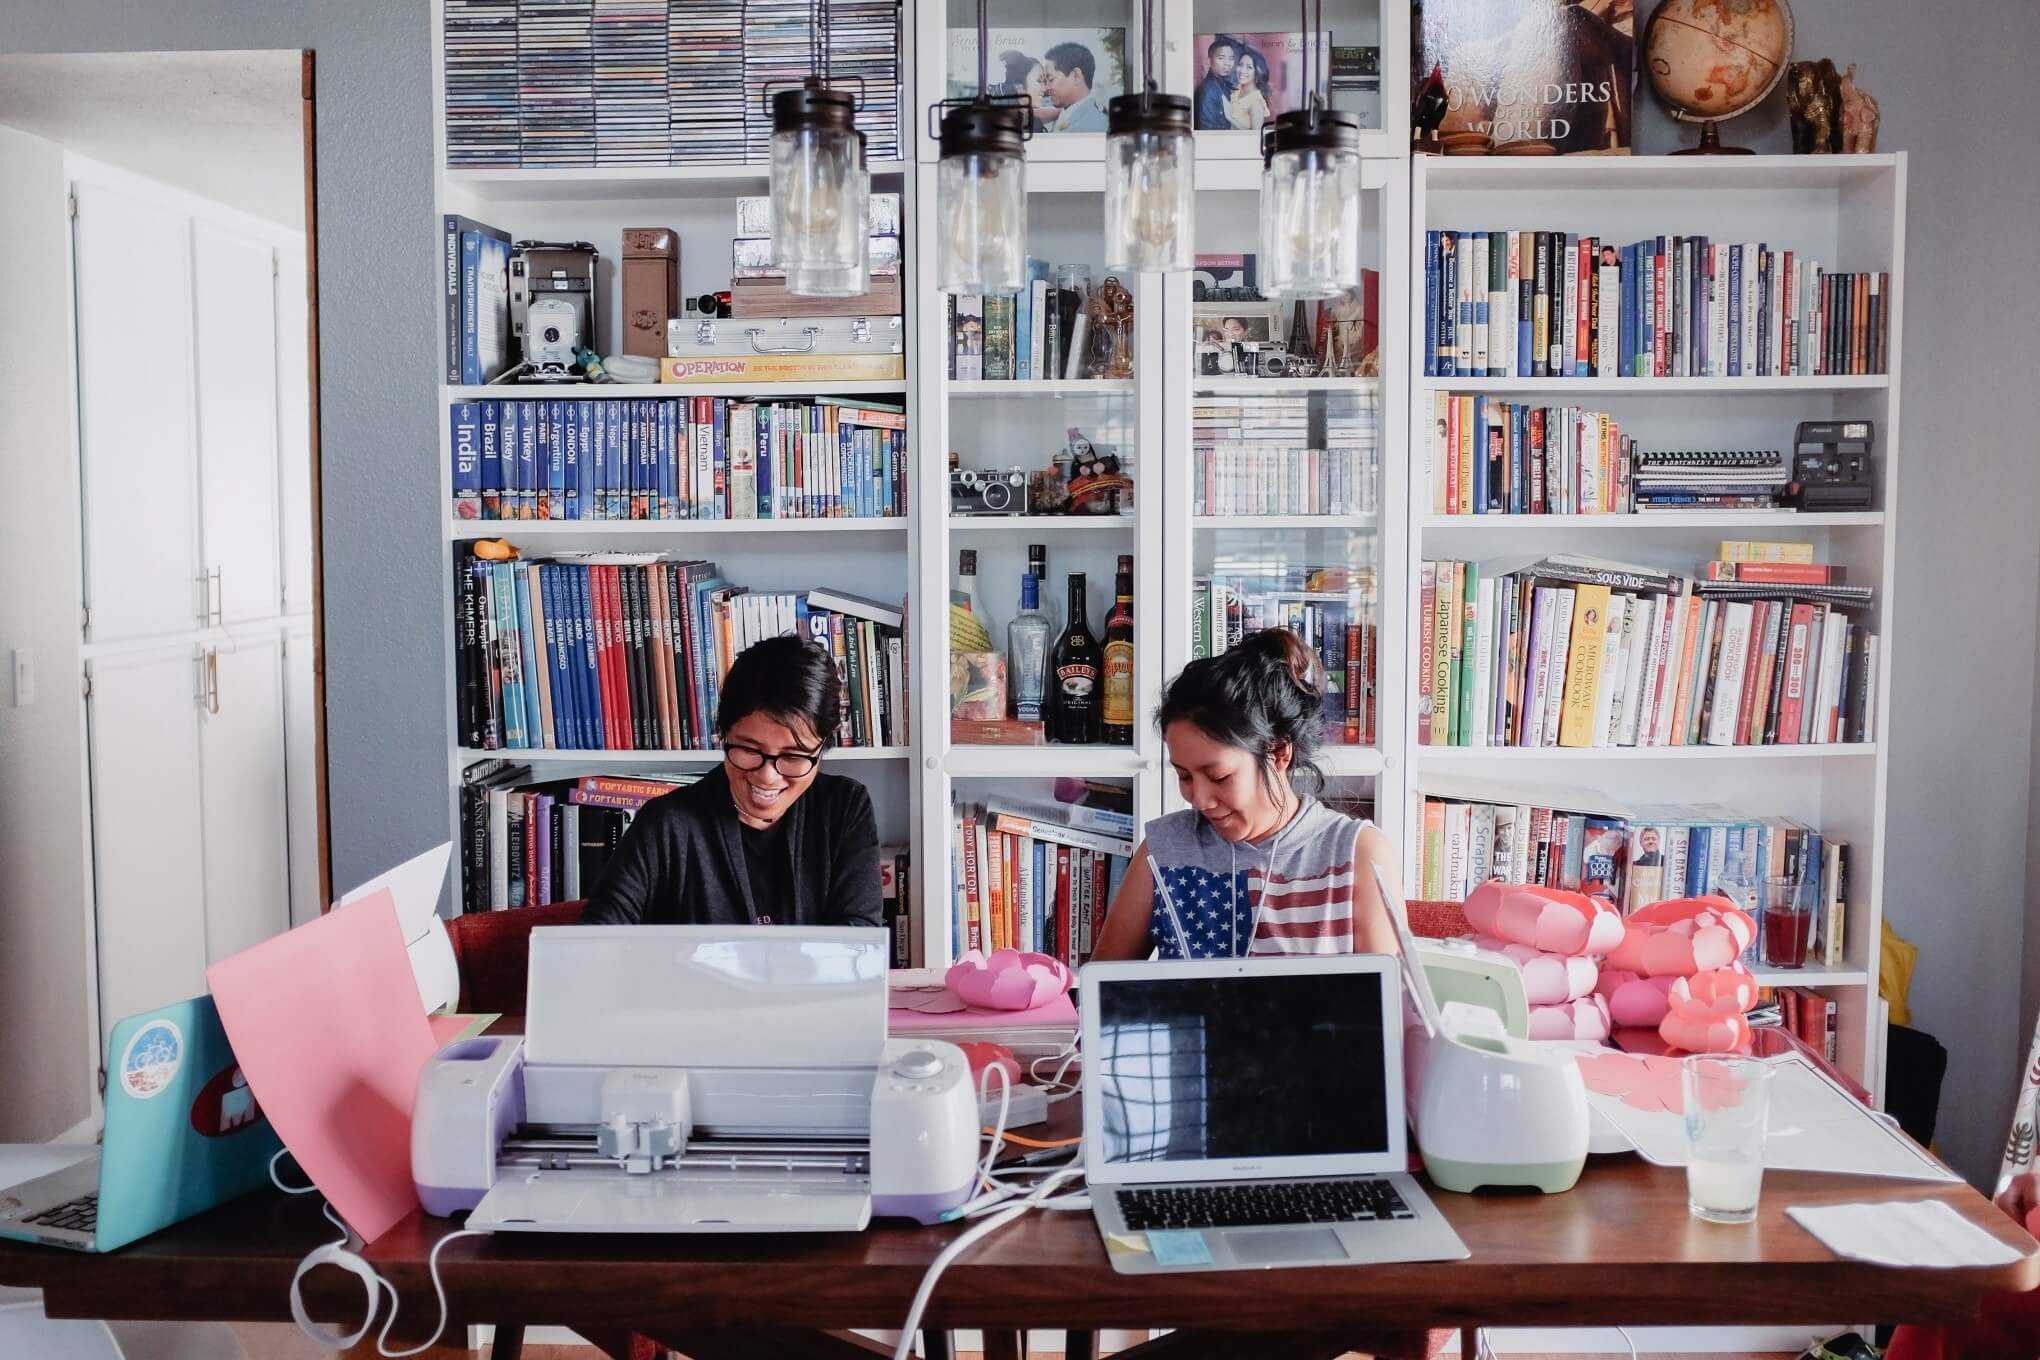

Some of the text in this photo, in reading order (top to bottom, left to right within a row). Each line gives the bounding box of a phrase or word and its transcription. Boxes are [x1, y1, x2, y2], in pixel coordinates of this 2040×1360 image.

[1469, 81, 1612, 107] WONDERS
[1495, 107, 1543, 120] OF THE
[1467, 118, 1571, 142] WORLD
[447, 232, 457, 297] INDIVIDUALS
[1538, 245, 1547, 265] DAVE
[1448, 257, 1456, 283] Become
[1537, 265, 1546, 293] RAMSEY
[1646, 273, 1654, 291] STEPS
[1657, 267, 1665, 279] THE
[467, 265, 475, 334] TRANSFORMERS
[1448, 289, 1456, 308] Better
[1646, 293, 1654, 301] TO
[1657, 280, 1665, 293] ART
[1448, 308, 1456, 321] You
[1591, 302, 1599, 330] Poor Dad
[672, 360, 748, 378] OPERATION
[484, 422, 497, 459] Brazil
[503, 424, 515, 462] Turkey
[520, 425, 534, 462] Turkey
[538, 422, 547, 445] PARIS
[551, 422, 562, 472] Argentina
[566, 422, 576, 465] LONDON
[579, 426, 590, 453] Egypt
[594, 421, 605, 466] Philippines
[608, 424, 618, 448] Nepal
[640, 421, 648, 465] AMSTERDAM
[760, 432, 769, 457] Peru
[457, 423, 477, 474] India
[699, 425, 710, 472] Vietnam
[900, 450, 908, 473] Czech
[891, 451, 900, 481] German
[1596, 573, 1646, 589] SOUS VIDE
[464, 565, 476, 646] THE KHMERS
[681, 598, 690, 627] KYOTO
[1193, 597, 1206, 642] Western
[478, 618, 490, 650] People
[545, 619, 555, 644] PRAGUE
[565, 618, 575, 648] BOMBAY
[574, 618, 583, 640] CAIRO
[613, 620, 622, 643] TOKYO
[623, 619, 632, 642] BERLIN
[633, 618, 643, 650] ISTANBUL
[643, 618, 651, 638] PARIS
[672, 619, 680, 635] NEW
[1766, 603, 1780, 651] BRAISE
[1781, 607, 1791, 638] FRESH
[555, 618, 567, 670] SAN FRANCISCO
[584, 618, 596, 670] RIO DE JANEIRO
[672, 636, 682, 655] YORK
[1422, 603, 1433, 693] TURKISH COOKING
[1434, 599, 1451, 714] Japanese Cooking
[1659, 620, 1672, 666] SUPER FOODS
[1725, 627, 1738, 681] COOKBOOK
[850, 663, 858, 679] Love
[1056, 664, 1098, 681] BAILEYS
[1536, 671, 1546, 699] COOKING
[1570, 645, 1587, 709] COOKBOOK
[1581, 643, 1598, 712] MICROWAVE
[1349, 666, 1358, 709] revolution
[1017, 705, 1038, 714] VODKA
[589, 793, 634, 807] POPTASTIC
[599, 781, 670, 797] POPTASTIC FARM
[474, 798, 485, 868] ANNE GEDDES
[1538, 808, 1550, 842] MARVEL
[511, 830, 521, 878] LEIBOVITZ
[1675, 839, 1687, 855] SIX
[1449, 832, 1465, 900] cardmakin
[1674, 858, 1687, 883] DAYS
[966, 823, 980, 948] TONY HORTON Bring
[1082, 869, 1092, 926] WAITER RANT
